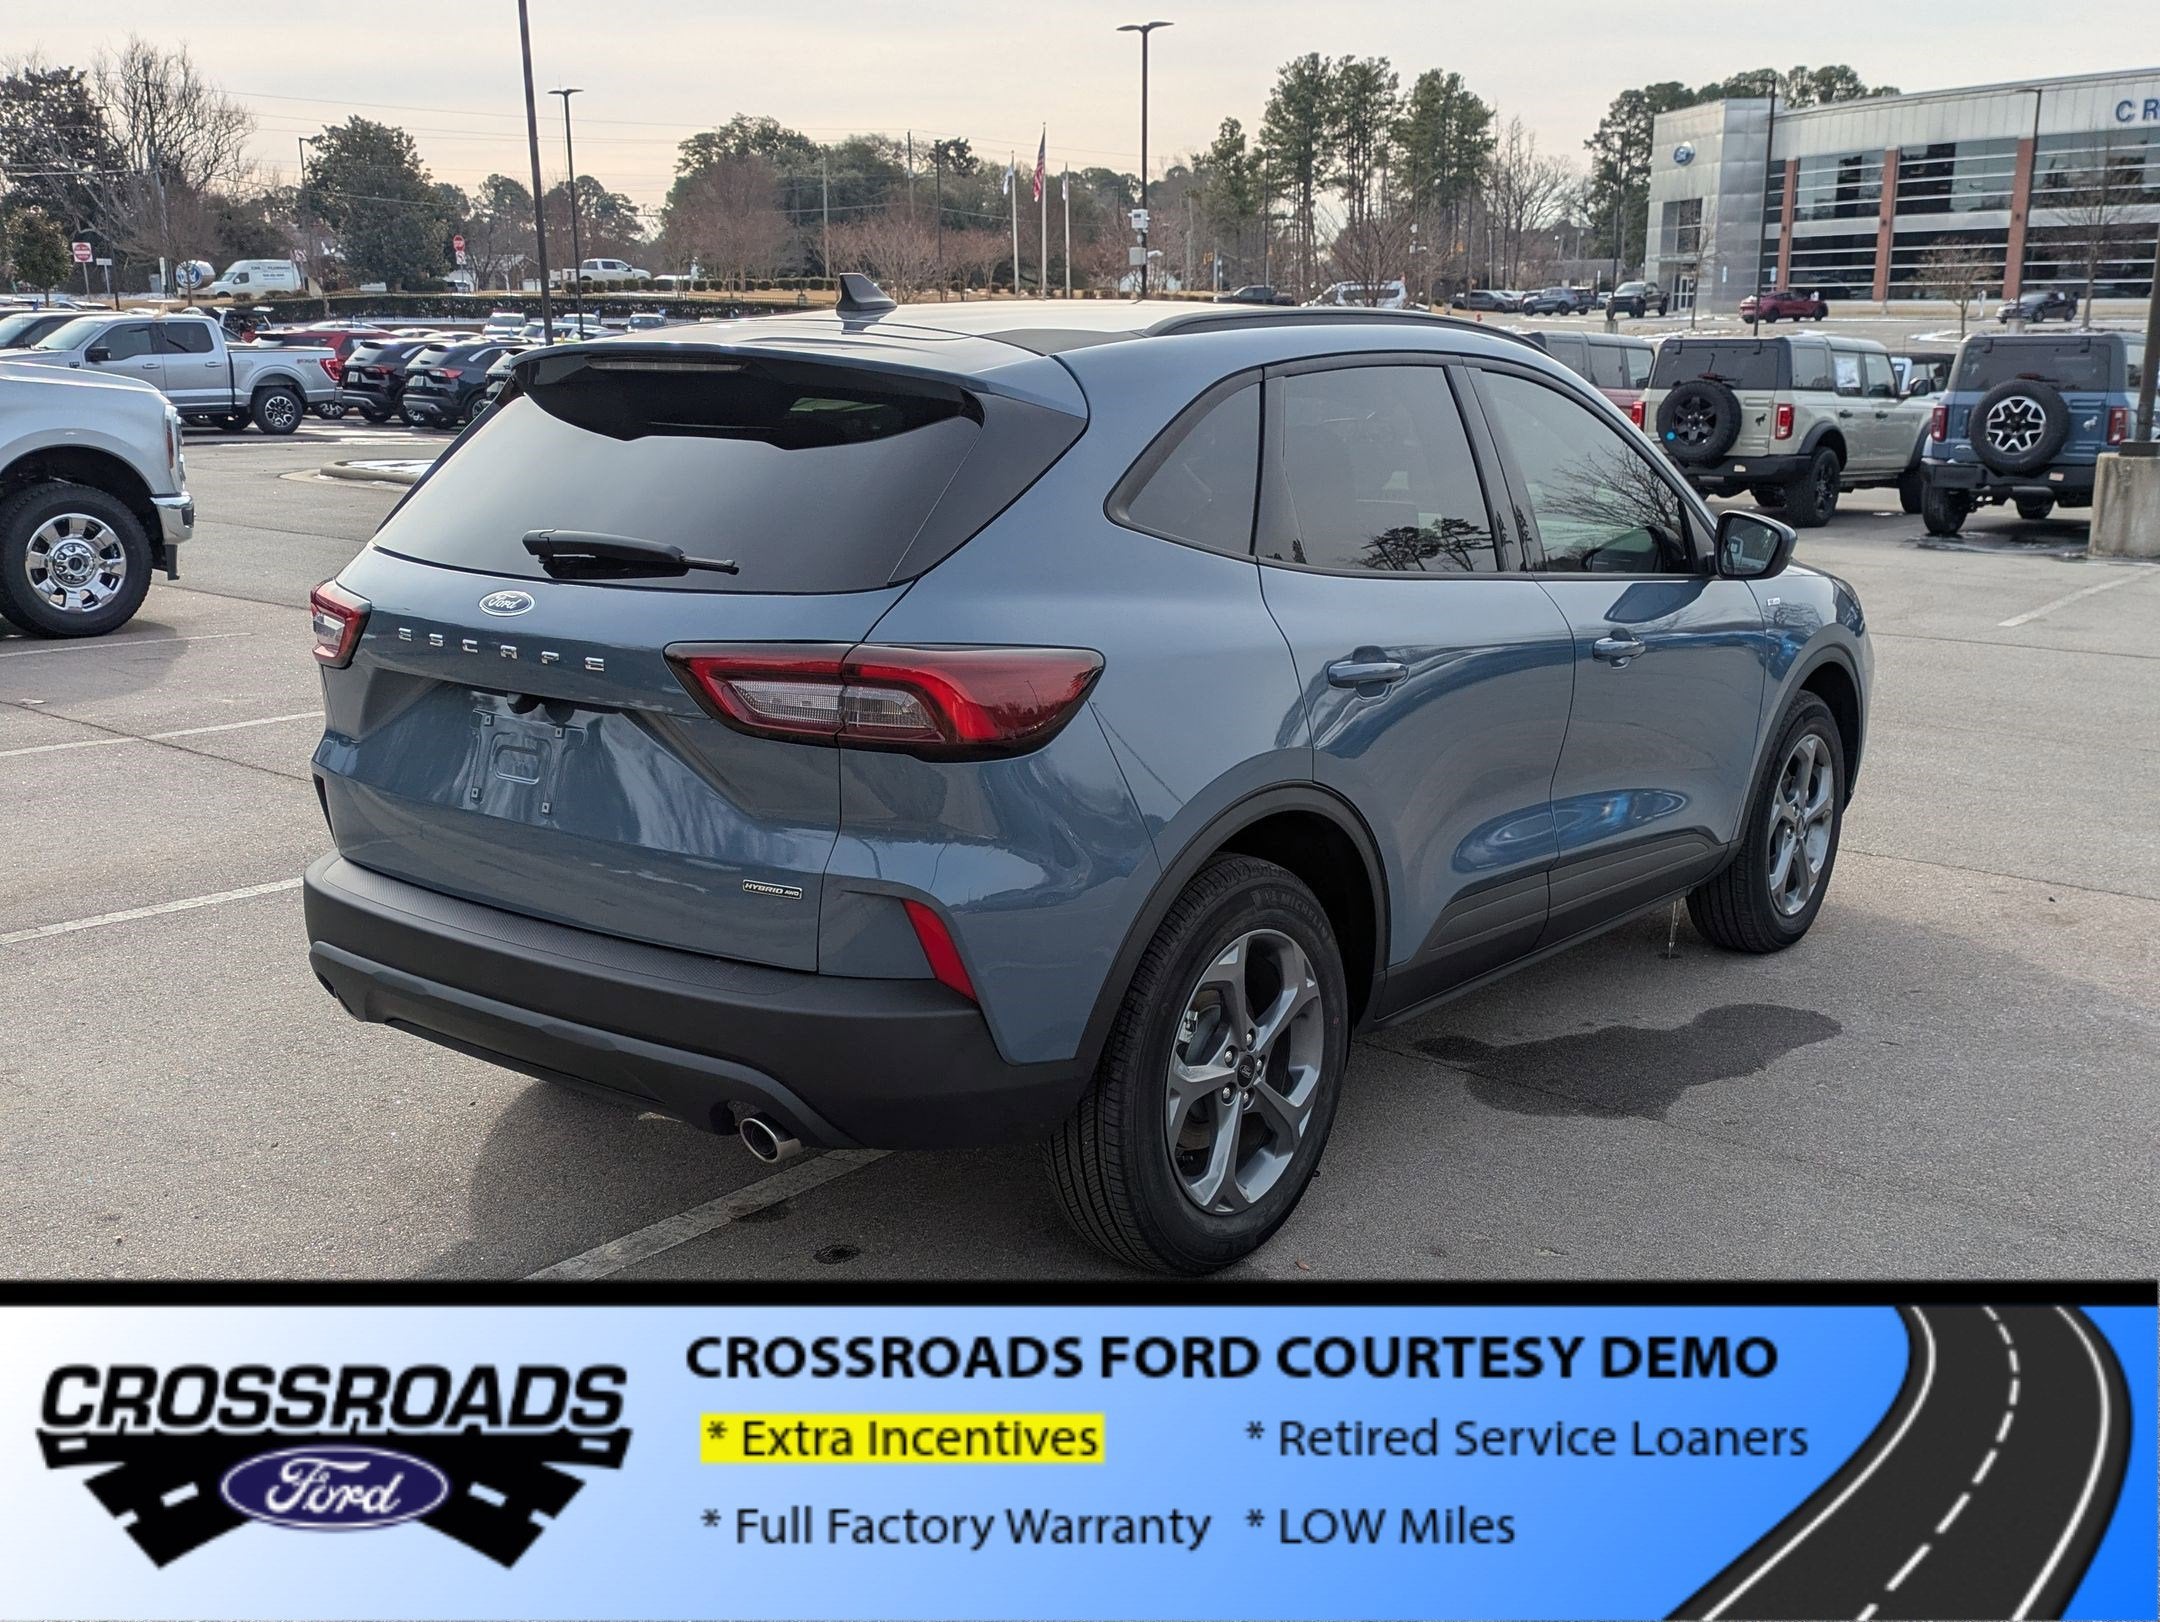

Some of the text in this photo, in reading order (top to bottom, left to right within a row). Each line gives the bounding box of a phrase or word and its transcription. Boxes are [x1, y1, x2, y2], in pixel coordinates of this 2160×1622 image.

[398, 627, 605, 673] ESCAPE
[744, 882, 800, 897] HYBRID AWD
